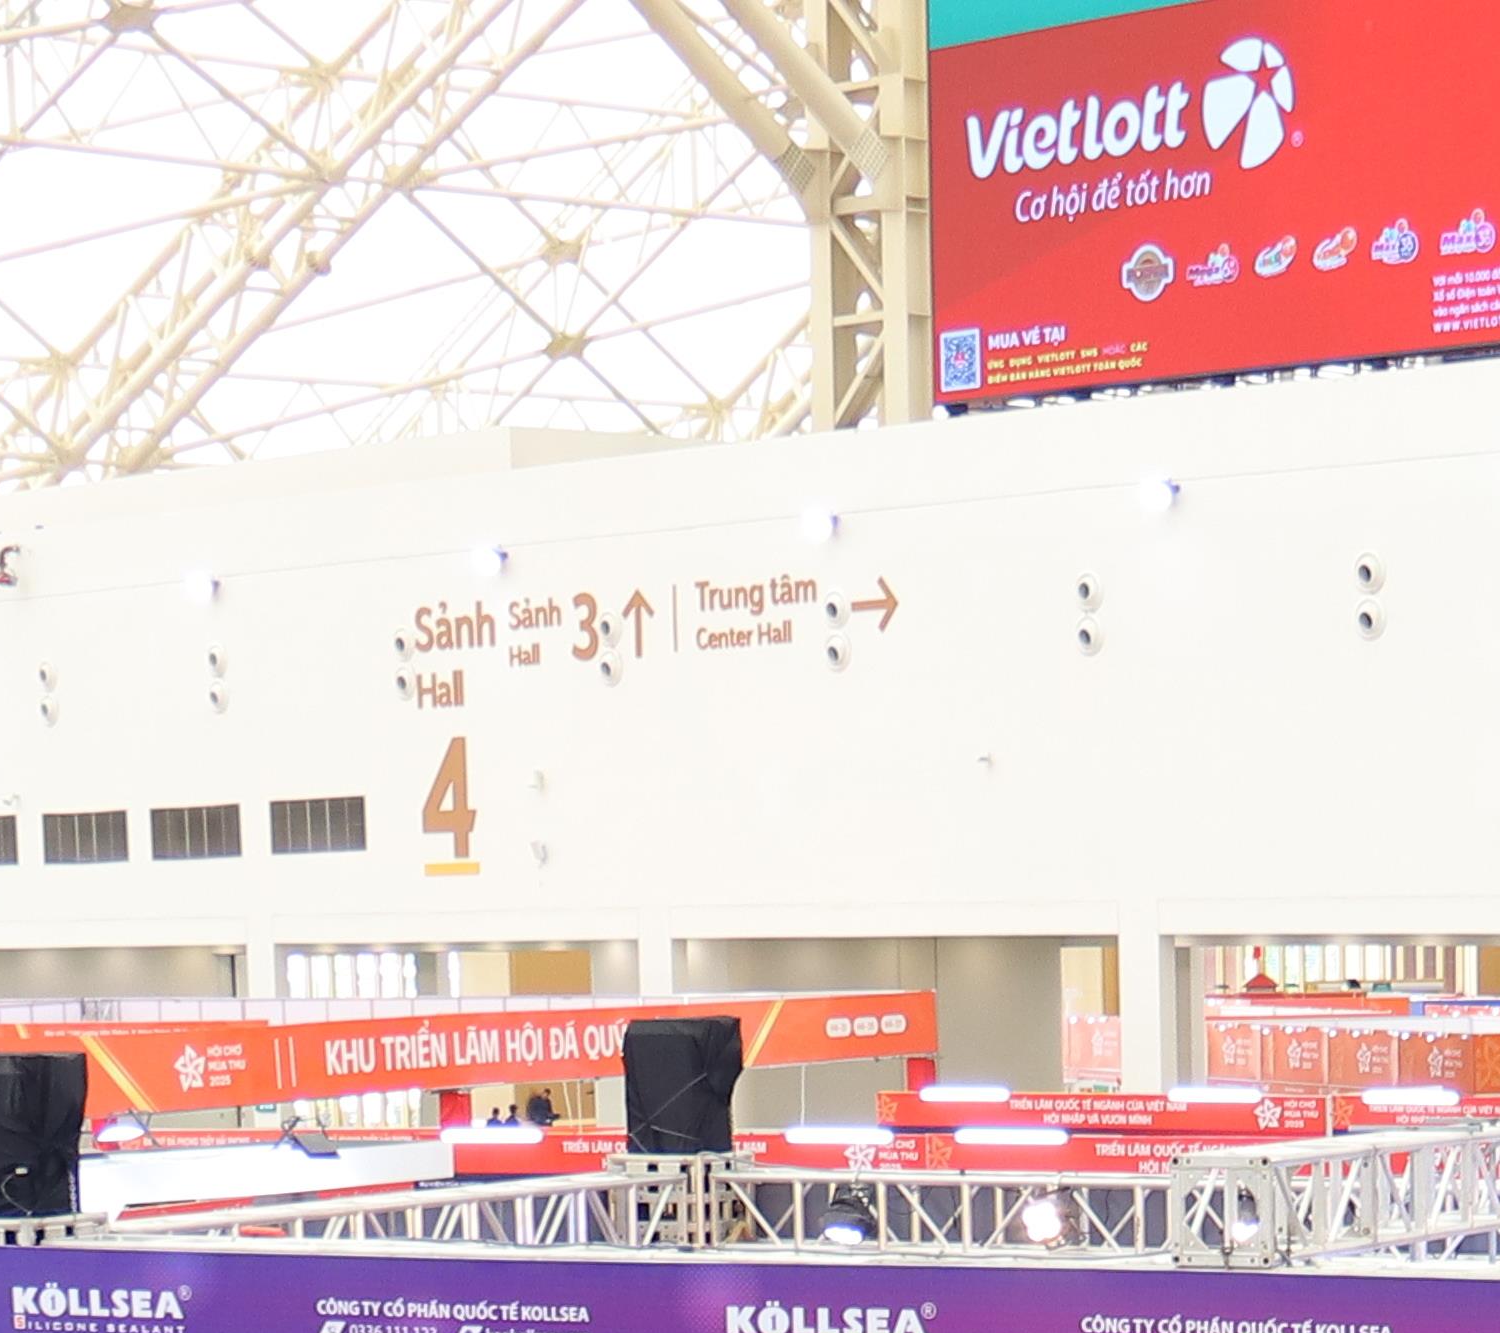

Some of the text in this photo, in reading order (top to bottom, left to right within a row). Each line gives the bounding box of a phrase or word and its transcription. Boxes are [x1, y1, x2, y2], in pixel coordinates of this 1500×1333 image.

[966, 81, 1190, 179] Vietlott
[1015, 167, 1212, 223] Cơ hội để tốt hơn
[987, 325, 1066, 351] MUA VÉ TẠI
[695, 574, 818, 616] Trung tâm
[414, 601, 497, 652] Sảnh
[508, 591, 598, 661] Sảnh 3
[696, 621, 793, 651] Center Hall
[508, 643, 541, 668] Hall
[416, 670, 464, 709] Hall
[422, 736, 477, 858] 4
[324, 1038, 377, 1075] KHU
[381, 1019, 450, 1072] TRIỂN
[453, 1027, 501, 1064] LÃM
[504, 1028, 546, 1069] HỘI
[548, 1023, 583, 1058] ĐÁ
[11, 1282, 184, 1321] KÖLLSEA
[13, 1314, 101, 1333] SILICONE
